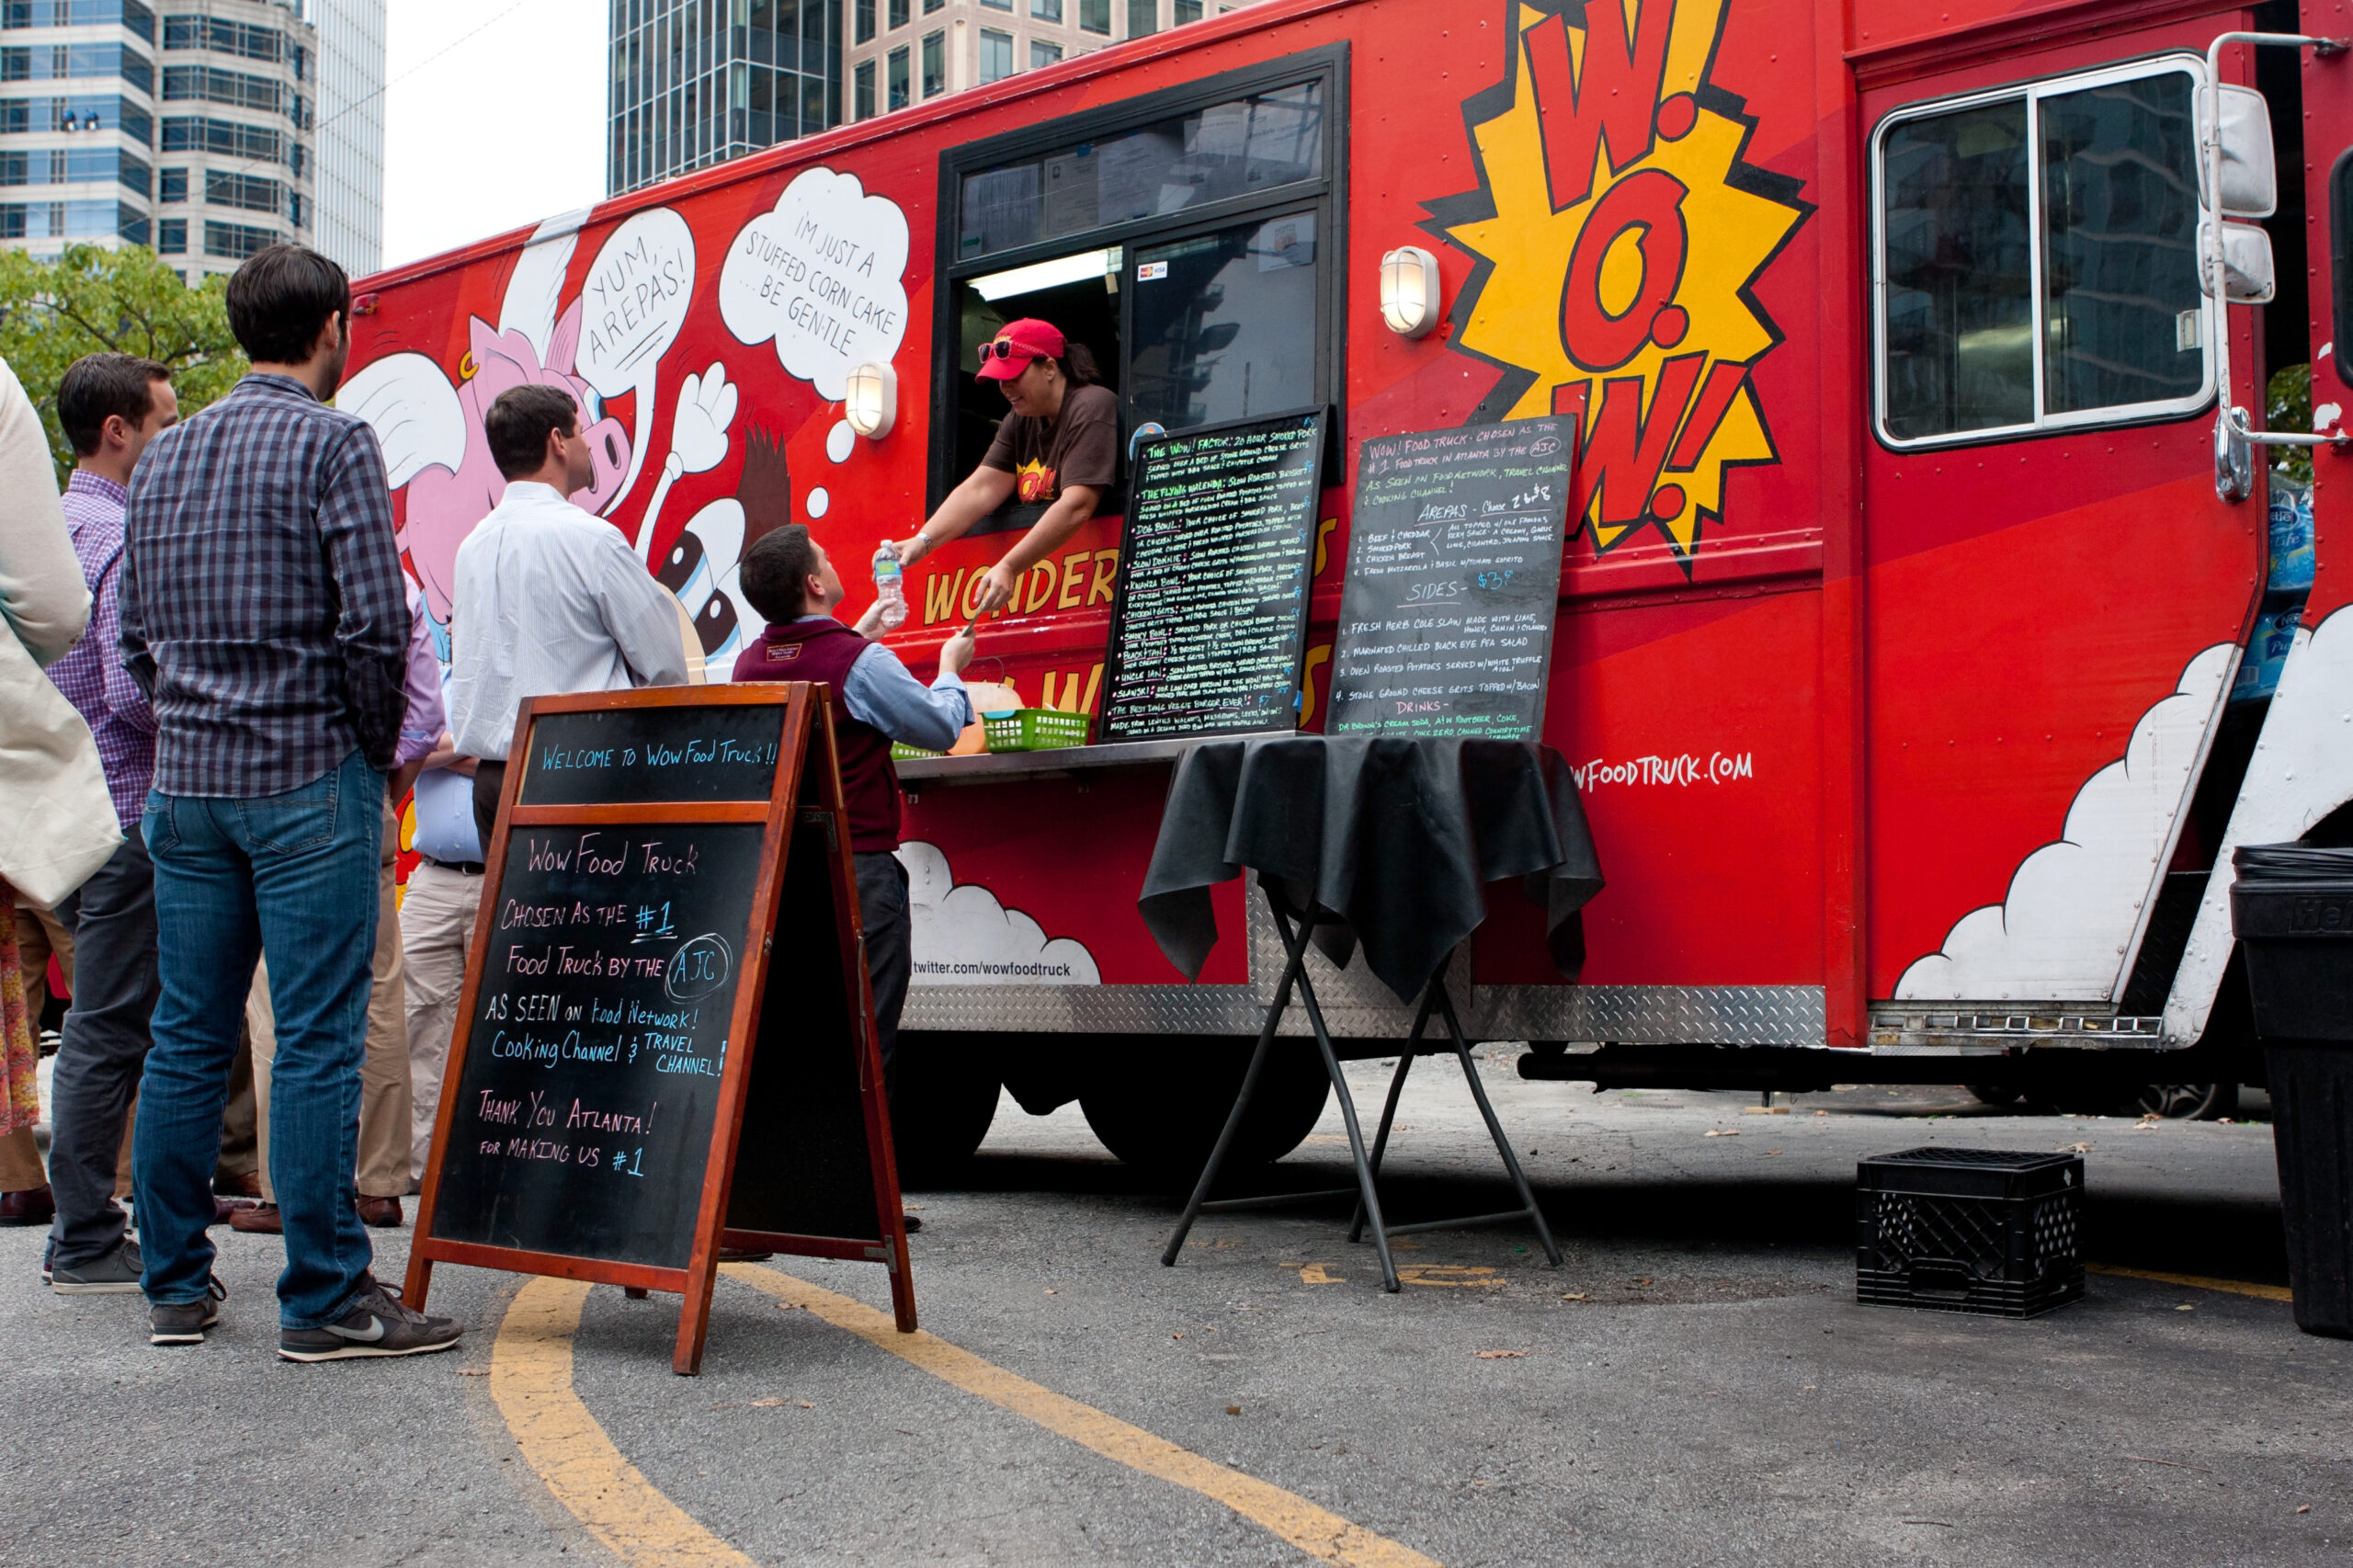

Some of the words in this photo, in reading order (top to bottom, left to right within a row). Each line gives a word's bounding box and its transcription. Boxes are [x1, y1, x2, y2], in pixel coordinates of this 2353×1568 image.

[795, 210, 818, 244] I'M
[816, 233, 859, 267] JUST
[858, 252, 875, 278] A
[592, 236, 657, 305] YUM,
[746, 232, 806, 283] STUFFED
[810, 270, 856, 310] CORN
[853, 296, 897, 335] CAKE
[589, 248, 686, 364] AREPAS!
[789, 296, 857, 357] GENTLE
[1145, 442, 1166, 460] THE
[1169, 437, 1196, 457] WOW!
[1233, 435, 1245, 446] 20
[1246, 432, 1267, 446] HOUR
[1268, 427, 1296, 444] SMOKED
[1296, 426, 1317, 438] PORK
[1368, 440, 1402, 459] WOW!
[1404, 437, 1431, 453] FOOD
[1433, 433, 1468, 449] TRUCK
[1475, 426, 1515, 441] CHOSEN
[1518, 426, 1531, 435] AS
[1537, 421, 1558, 433] THE
[1394, 456, 1413, 470] FOOD
[1413, 455, 1438, 467] TRUCK
[1442, 451, 1452, 463] IN
[1454, 448, 1489, 462] ATLANTA
[1493, 447, 1506, 459] BY
[1507, 445, 1527, 456] THE
[1530, 438, 1555, 454] AJC
[1140, 486, 1159, 501] THE
[1159, 483, 1187, 498] FLYING
[1227, 474, 1246, 487] SLOW
[1247, 469, 1277, 483] ROASTED
[1365, 478, 1381, 492] AS
[1385, 474, 1411, 488] SEEN
[1415, 473, 1427, 483] ON
[1432, 471, 1453, 483] FOOD
[1503, 464, 1534, 479] TRAVEL
[1372, 491, 1406, 506] COOKING
[1416, 499, 1468, 521] AREPAS
[1511, 494, 1520, 508] 2
[1135, 522, 1154, 534] DOG
[1367, 531, 1388, 543] BEEF
[1396, 528, 1431, 540] CHEDDAR
[1393, 541, 1412, 551] PORK
[2275, 533, 2301, 549] Life
[1131, 559, 1151, 569] SLOW
[1365, 553, 1394, 563] CHICKEN
[1398, 551, 1425, 561] BREAST
[1435, 559, 1457, 568] BASIL
[1350, 620, 1381, 634] FRESH
[1385, 619, 1410, 631] HERB
[1413, 618, 1434, 629] COLE
[1436, 616, 1461, 628] SLAW
[1465, 615, 1487, 624] MADE
[1491, 614, 1510, 623] WITH
[1490, 623, 1514, 632] CUMIN
[1352, 644, 1394, 656] MARINATED
[1396, 642, 1430, 653] CHILLED
[1434, 641, 1458, 650] BLACK
[1460, 640, 1476, 649] EYE
[1481, 638, 1495, 646] PEA
[1500, 637, 1528, 646] SALAD
[1120, 671, 1144, 681] UNCLE
[1349, 664, 1370, 676] OVEN
[1373, 663, 1404, 673] ROASTED
[1406, 661, 1441, 671] POTATOES
[1512, 655, 1541, 664] TRUFFLE
[1348, 690, 1374, 700] STONE
[1379, 687, 1408, 698] GROUND
[1412, 687, 1443, 695] CHEESE
[1449, 685, 1473, 693] GRITS
[1478, 682, 1505, 691] TOPPED
[1110, 706, 1126, 715] THE
[1130, 704, 1145, 713] BEST
[1193, 698, 1221, 709] BURGER
[1109, 721, 1130, 730] MADE
[542, 744, 614, 770] WELCOME
[622, 748, 636, 767] TO
[686, 739, 716, 763] Food
[576, 832, 629, 875] Food
[501, 899, 565, 929] CHOSEN
[571, 901, 589, 925] AS
[597, 904, 627, 924] THE
[636, 901, 674, 933] #1
[506, 945, 551, 974] Food
[608, 958, 631, 978] BY
[635, 959, 665, 977] THE
[673, 951, 715, 983] AJC
[914, 960, 1071, 976] twitter.com/wowfoodtruck
[485, 993, 507, 1020] AS
[516, 995, 561, 1022] SEEN
[565, 1006, 582, 1022] ON
[591, 998, 623, 1024] Food
[644, 1033, 693, 1053] TRAVEL
[479, 1089, 521, 1125] THANK
[527, 1090, 555, 1129] YOU
[566, 1098, 657, 1134] ATLANTA!
[480, 1142, 501, 1154] FOR
[507, 1138, 570, 1163] MAKING
[579, 1147, 599, 1167] US
[613, 1148, 643, 1176] #1
